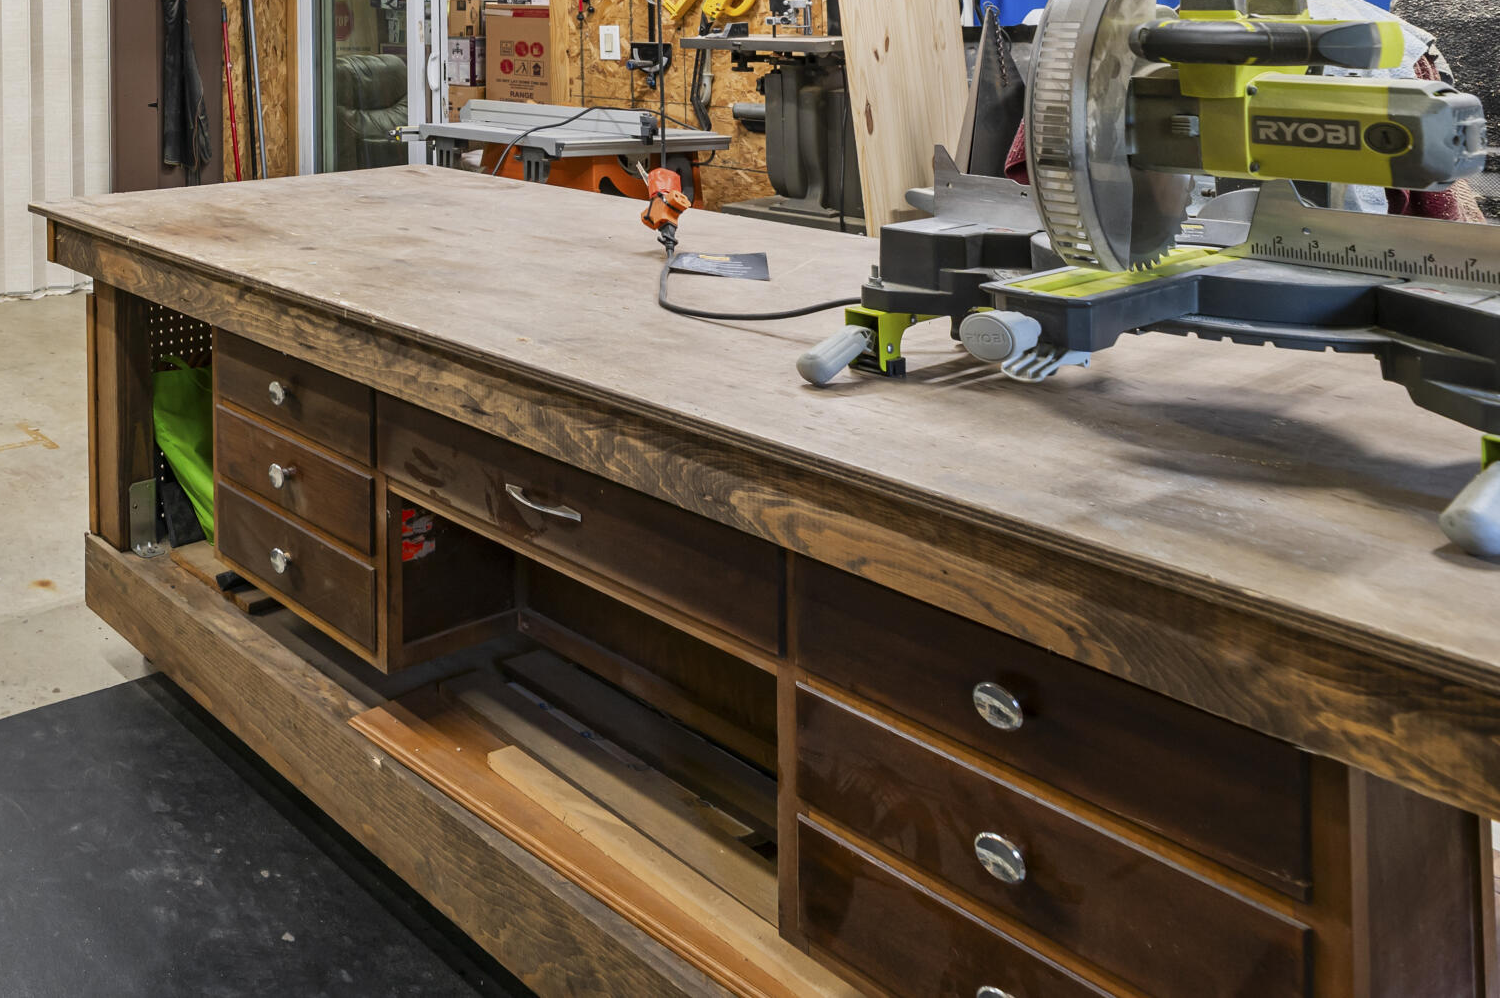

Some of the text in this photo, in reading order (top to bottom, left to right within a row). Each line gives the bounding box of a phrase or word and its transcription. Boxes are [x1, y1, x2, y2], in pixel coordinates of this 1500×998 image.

[510, 90, 534, 100] RANGE
[1255, 120, 1357, 146] RYOBI
[1275, 236, 1477, 268] 2 3 4 5 6 7
